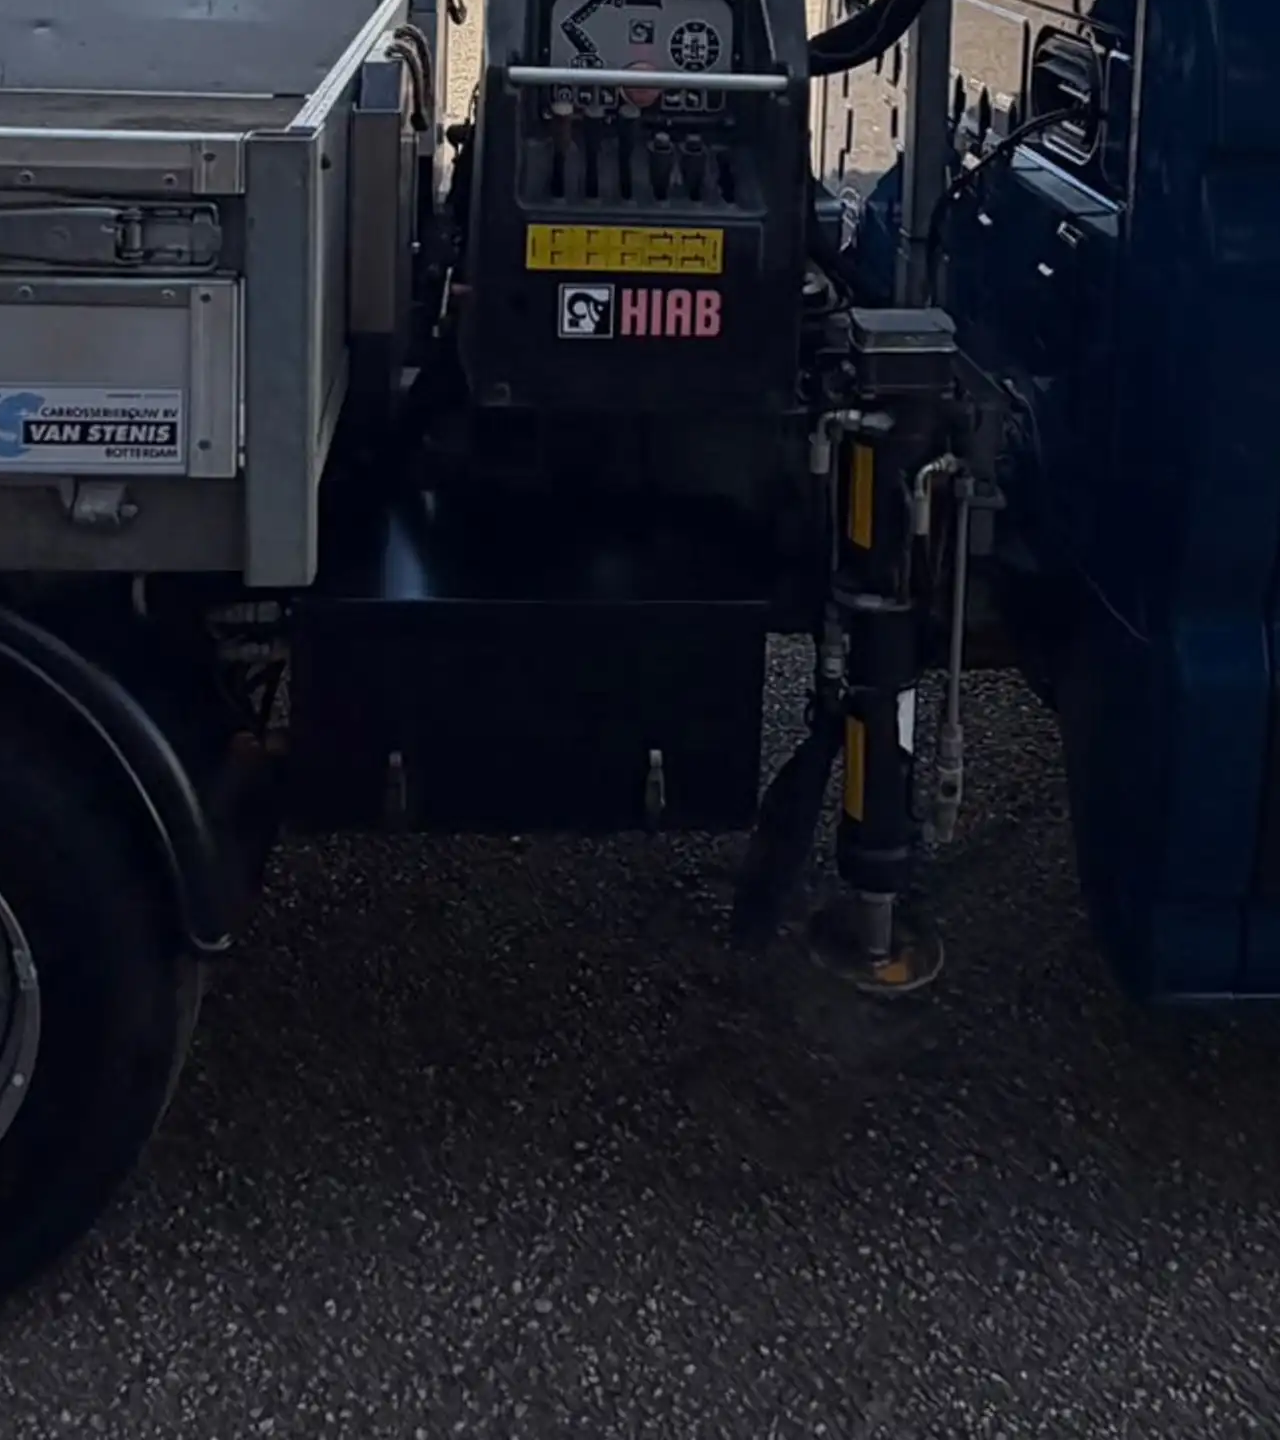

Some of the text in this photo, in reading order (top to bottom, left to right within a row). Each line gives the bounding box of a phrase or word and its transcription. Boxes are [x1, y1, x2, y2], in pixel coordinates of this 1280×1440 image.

[621, 288, 722, 337] HIAB
[29, 424, 171, 443] VAN STENIS
[105, 447, 178, 458] ROTTERDAM
